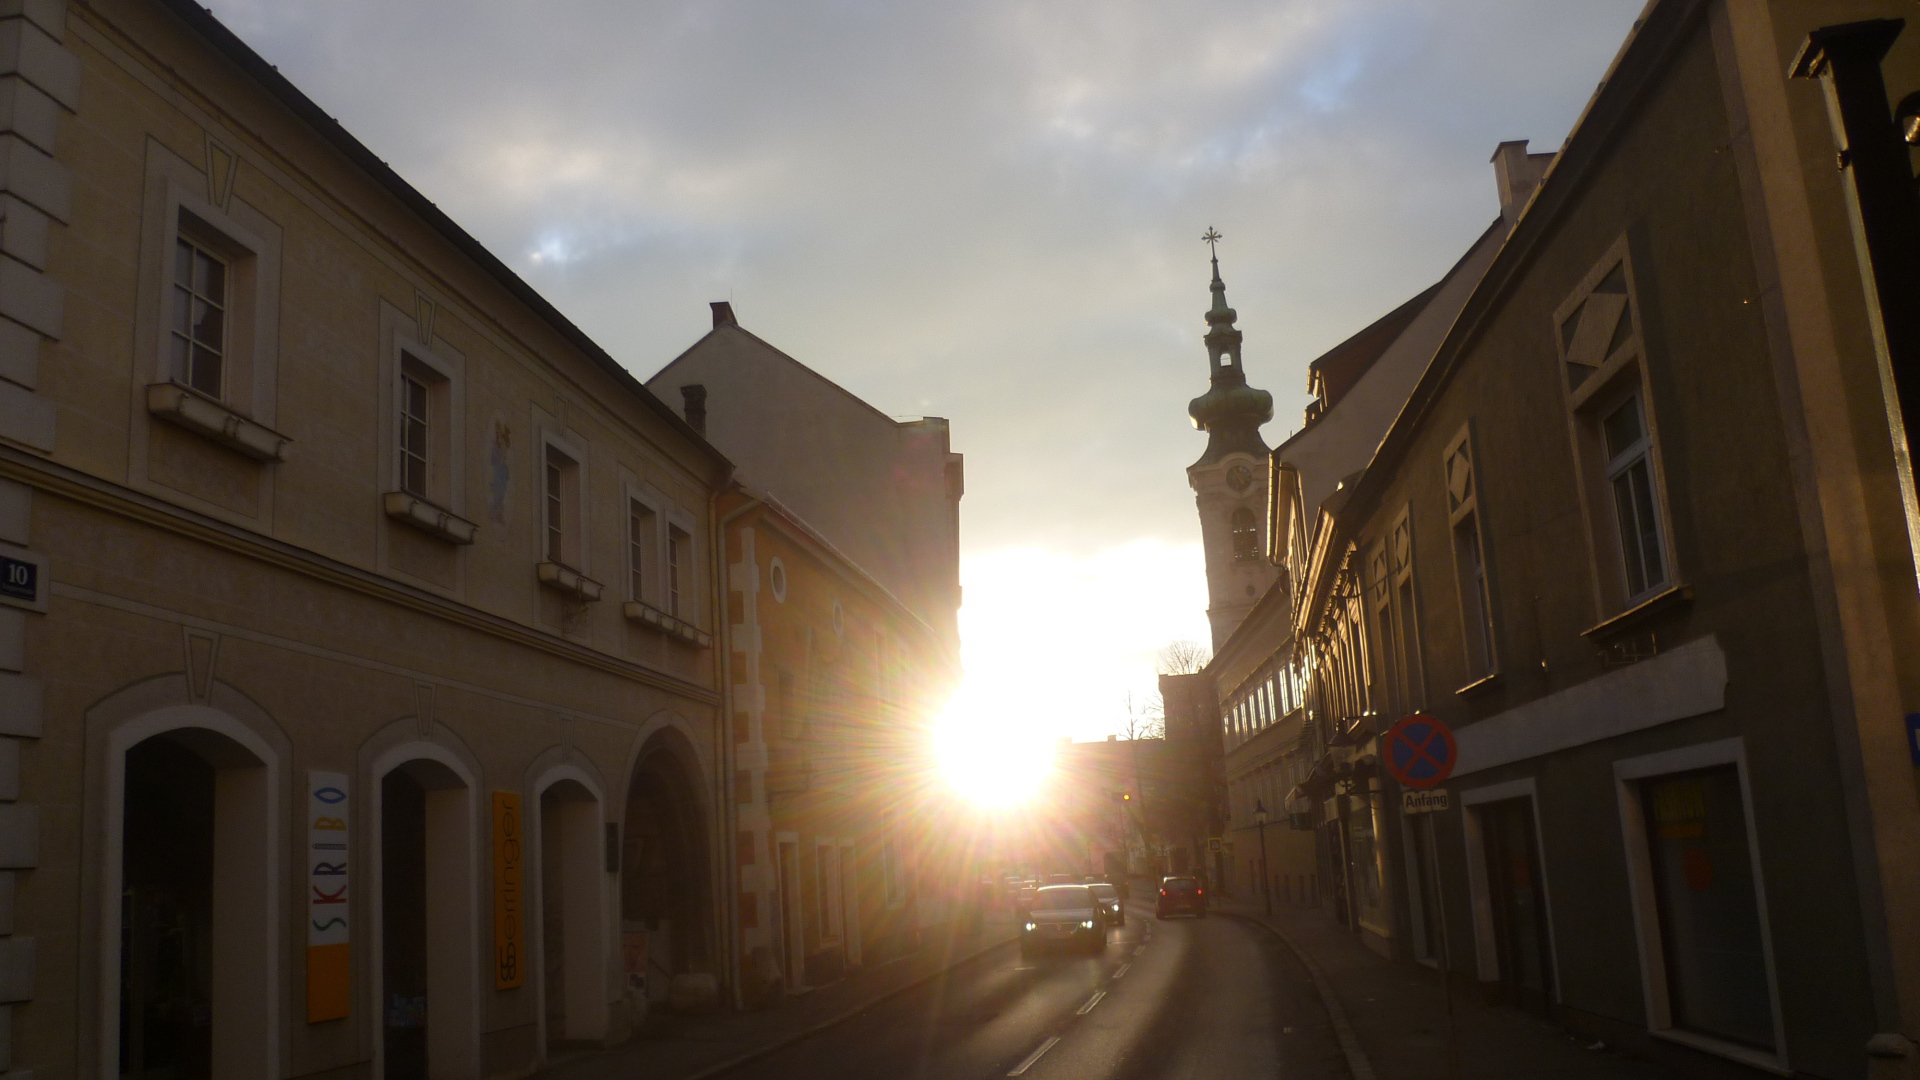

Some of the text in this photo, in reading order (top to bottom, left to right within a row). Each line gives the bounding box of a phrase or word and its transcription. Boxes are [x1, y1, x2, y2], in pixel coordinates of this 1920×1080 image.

[9, 564, 28, 585] 10
[1406, 792, 1448, 808] Anfang
[312, 787, 347, 932] SKRIBO
